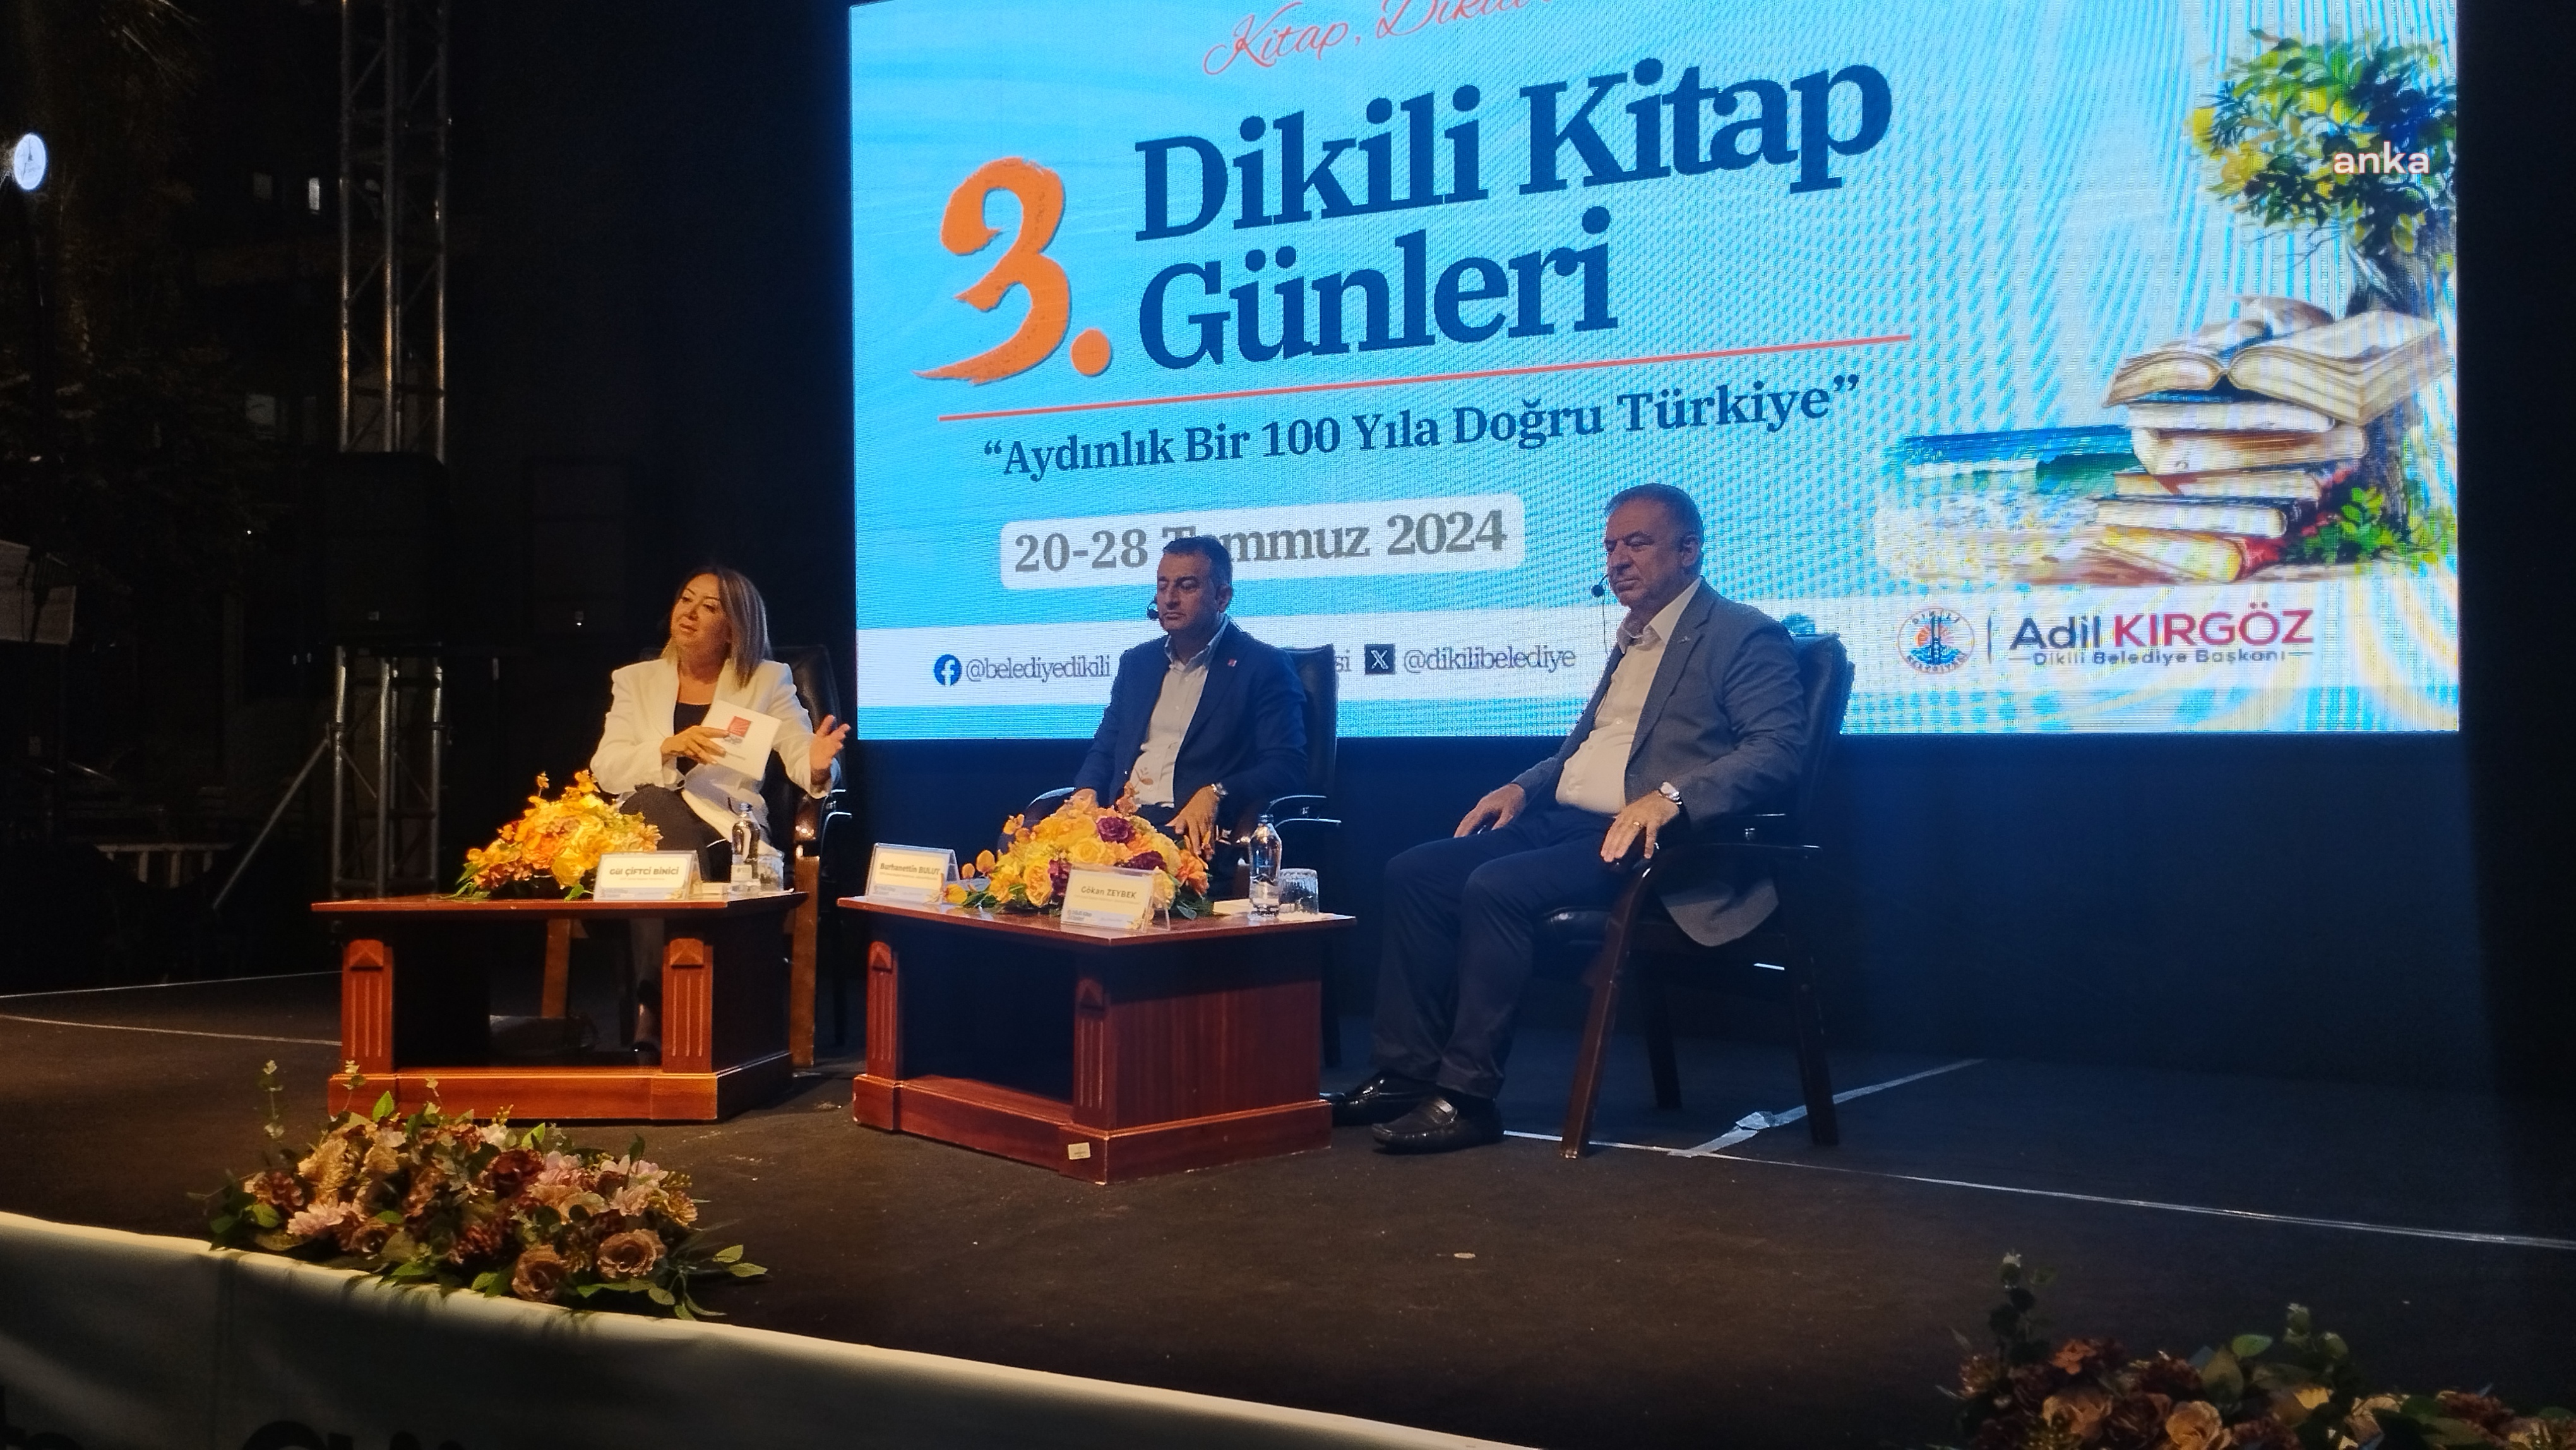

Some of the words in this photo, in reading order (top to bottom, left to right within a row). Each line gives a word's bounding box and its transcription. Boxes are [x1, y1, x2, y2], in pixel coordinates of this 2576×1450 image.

[1203, 2, 1361, 75] Kitap,
[1135, 85, 1489, 241] Dikili
[1519, 58, 1892, 195] Kitap
[911, 155, 1113, 386] 3.
[1140, 206, 1618, 369] Günleri
[984, 429, 1174, 482] “Aydınlık
[1185, 423, 1250, 462] Bir
[1261, 417, 1340, 457] 100
[1352, 410, 1440, 452] Yıla
[1452, 398, 1604, 449] Doğru
[1616, 374, 1859, 433] Türkiye”
[1014, 529, 1148, 573] 20-28
[1162, 525, 1369, 562] mmuz
[1388, 508, 1508, 555] 2024
[2009, 615, 2101, 650] Adil
[2114, 602, 2315, 647] KIRGÖZ
[966, 654, 1111, 683] @belediyedikili
[1404, 644, 1577, 673] @dikilibelediye
[2033, 651, 2085, 666] Dikili
[2093, 649, 2187, 666] Belediye
[2195, 649, 2286, 664] Başkanı
[919, 866, 941, 875] BULUT
[1107, 888, 1137, 899] ZEYBEK
